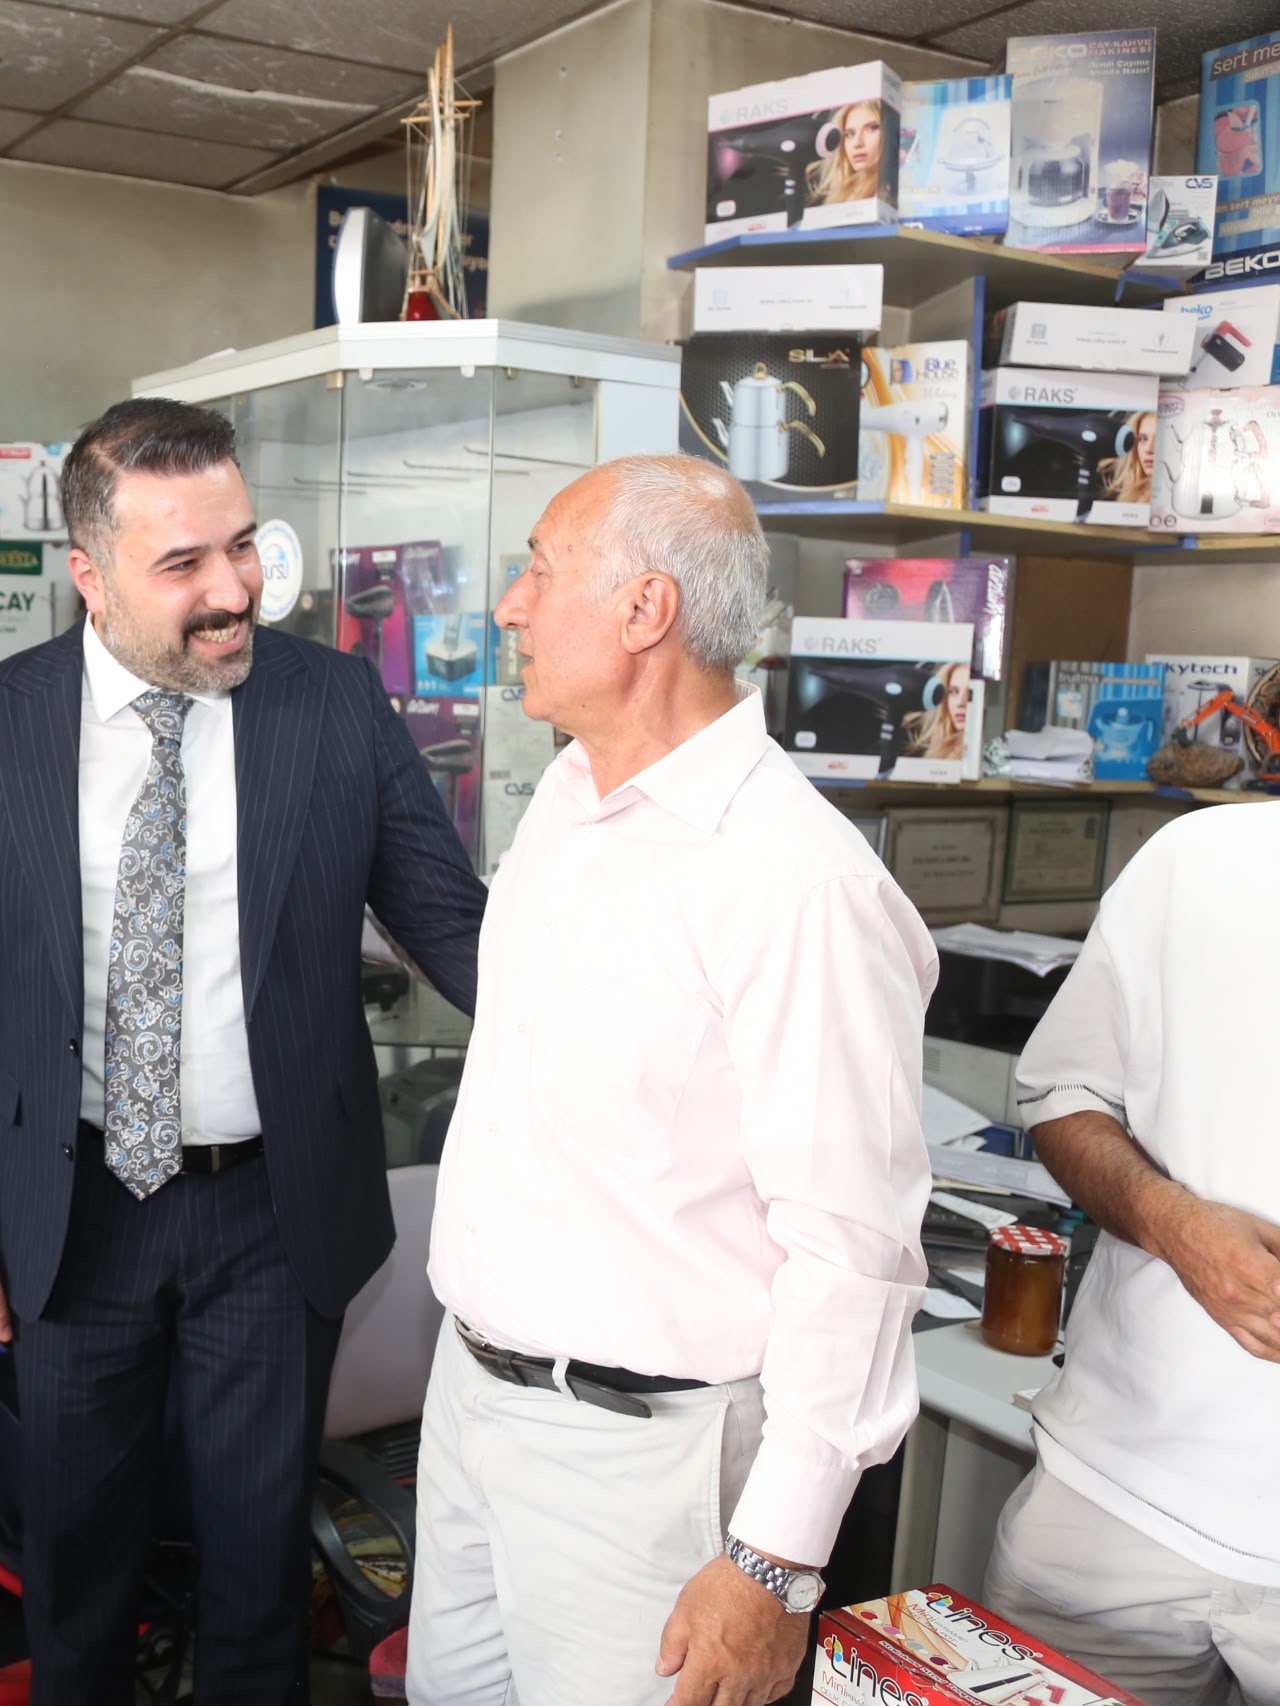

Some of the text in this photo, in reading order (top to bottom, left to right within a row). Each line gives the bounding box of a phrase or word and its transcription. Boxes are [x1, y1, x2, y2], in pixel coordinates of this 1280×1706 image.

[1213, 49, 1248, 75] sert
[736, 101, 788, 122] RAKS
[1204, 250, 1280, 279] BEKO
[1024, 386, 1075, 405] RAKS
[821, 637, 877, 655] RAKS
[926, 1594, 1036, 1661] Lines
